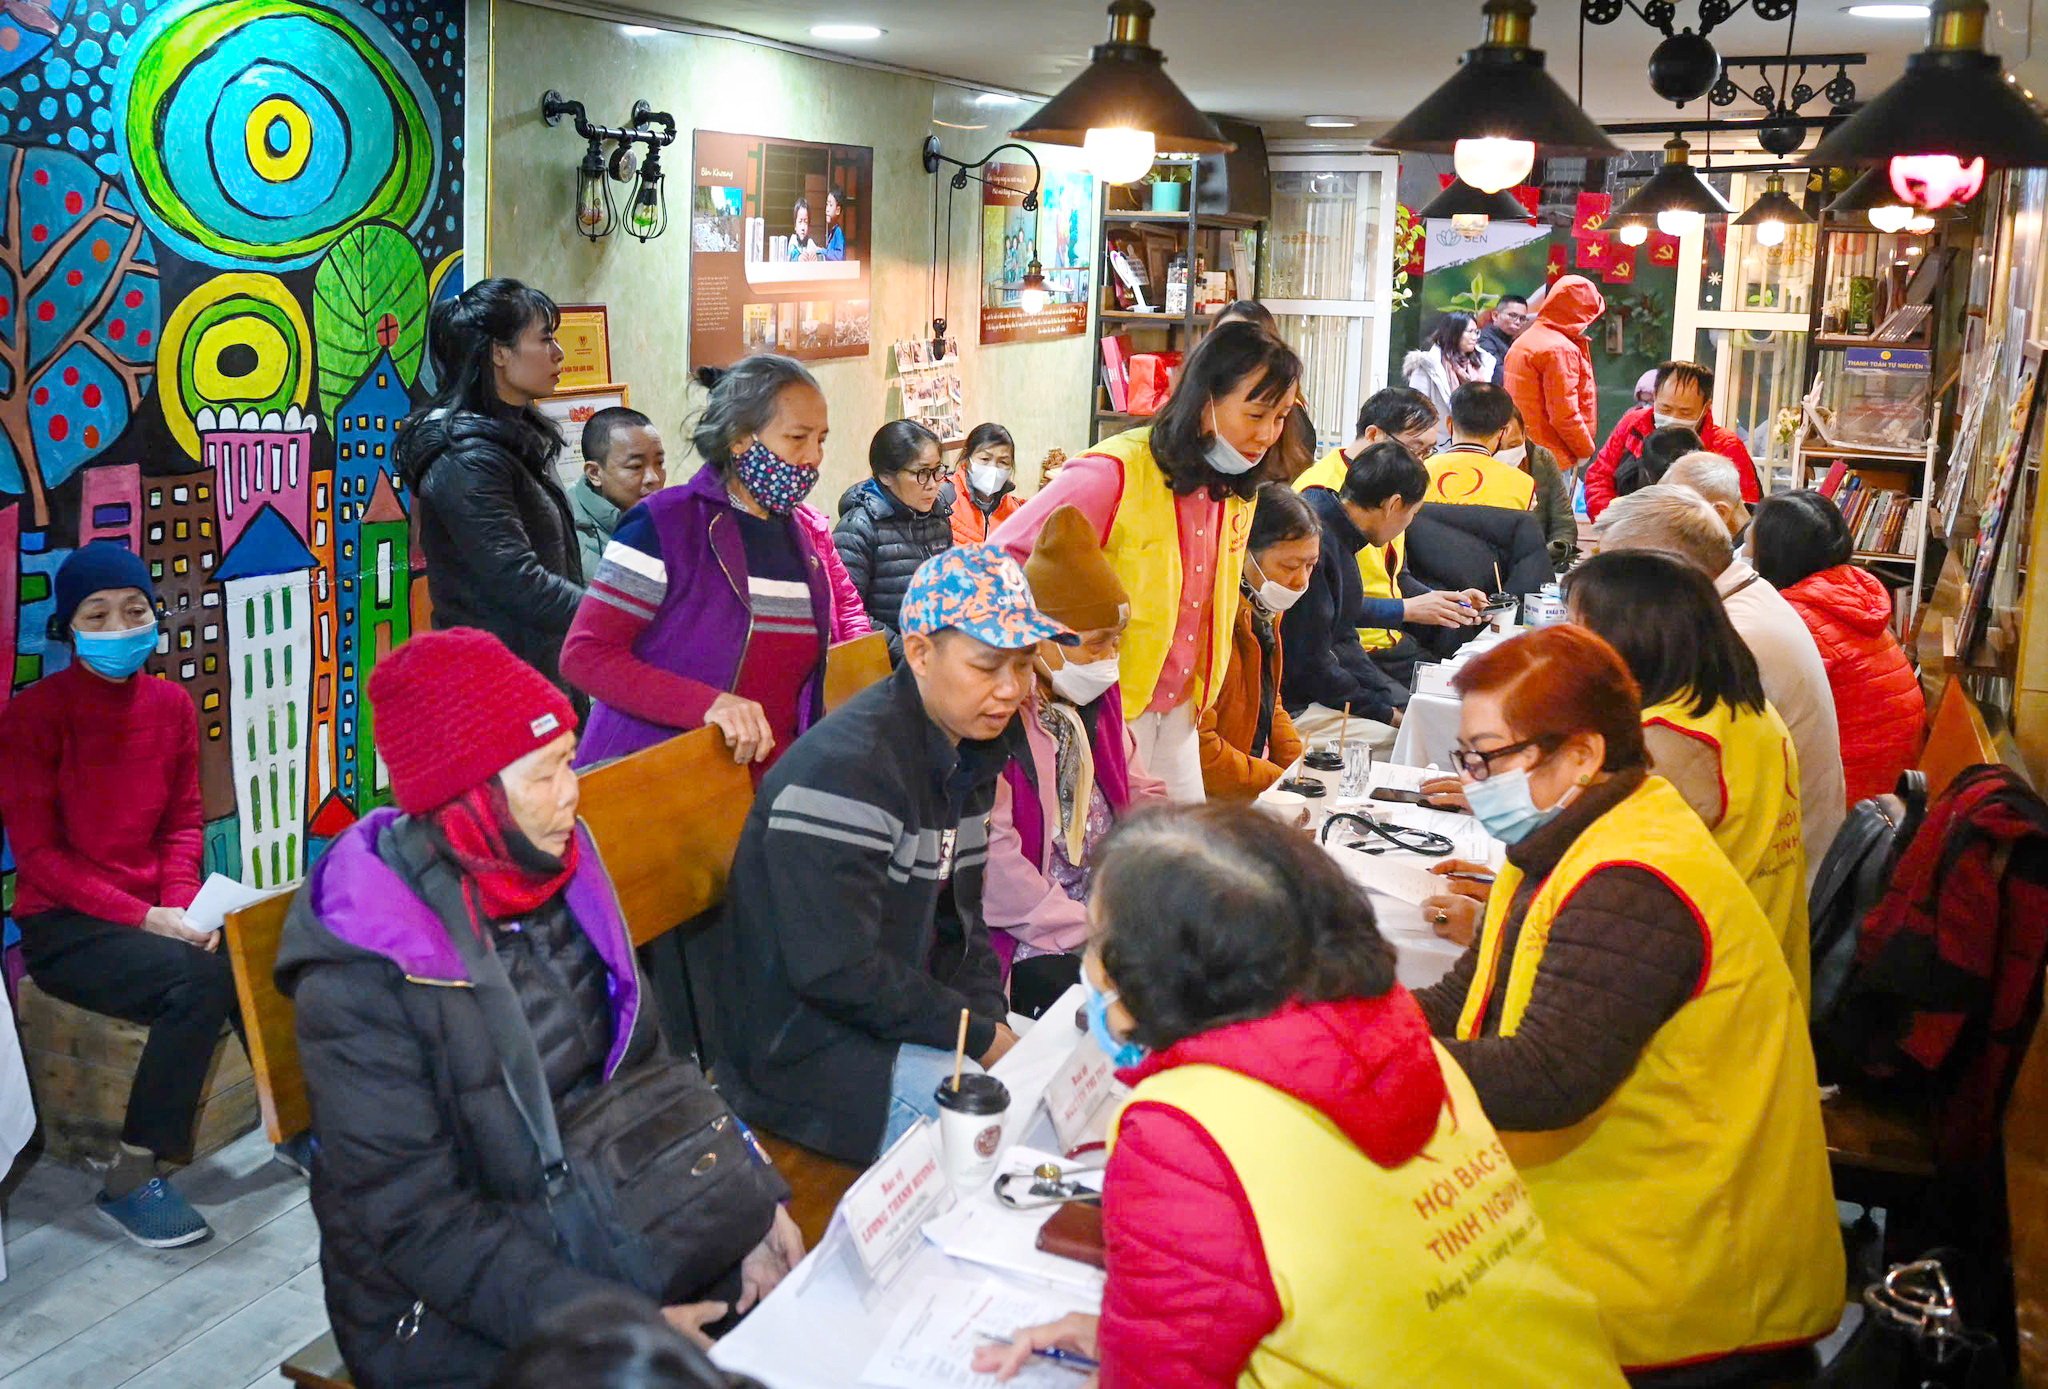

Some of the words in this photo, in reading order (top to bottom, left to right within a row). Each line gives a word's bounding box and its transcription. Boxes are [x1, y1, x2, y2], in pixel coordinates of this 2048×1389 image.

[1412, 1177, 1460, 1221] HỘI
[1452, 1148, 1497, 1190] BÁC
[1425, 1212, 1486, 1264] TÌNH
